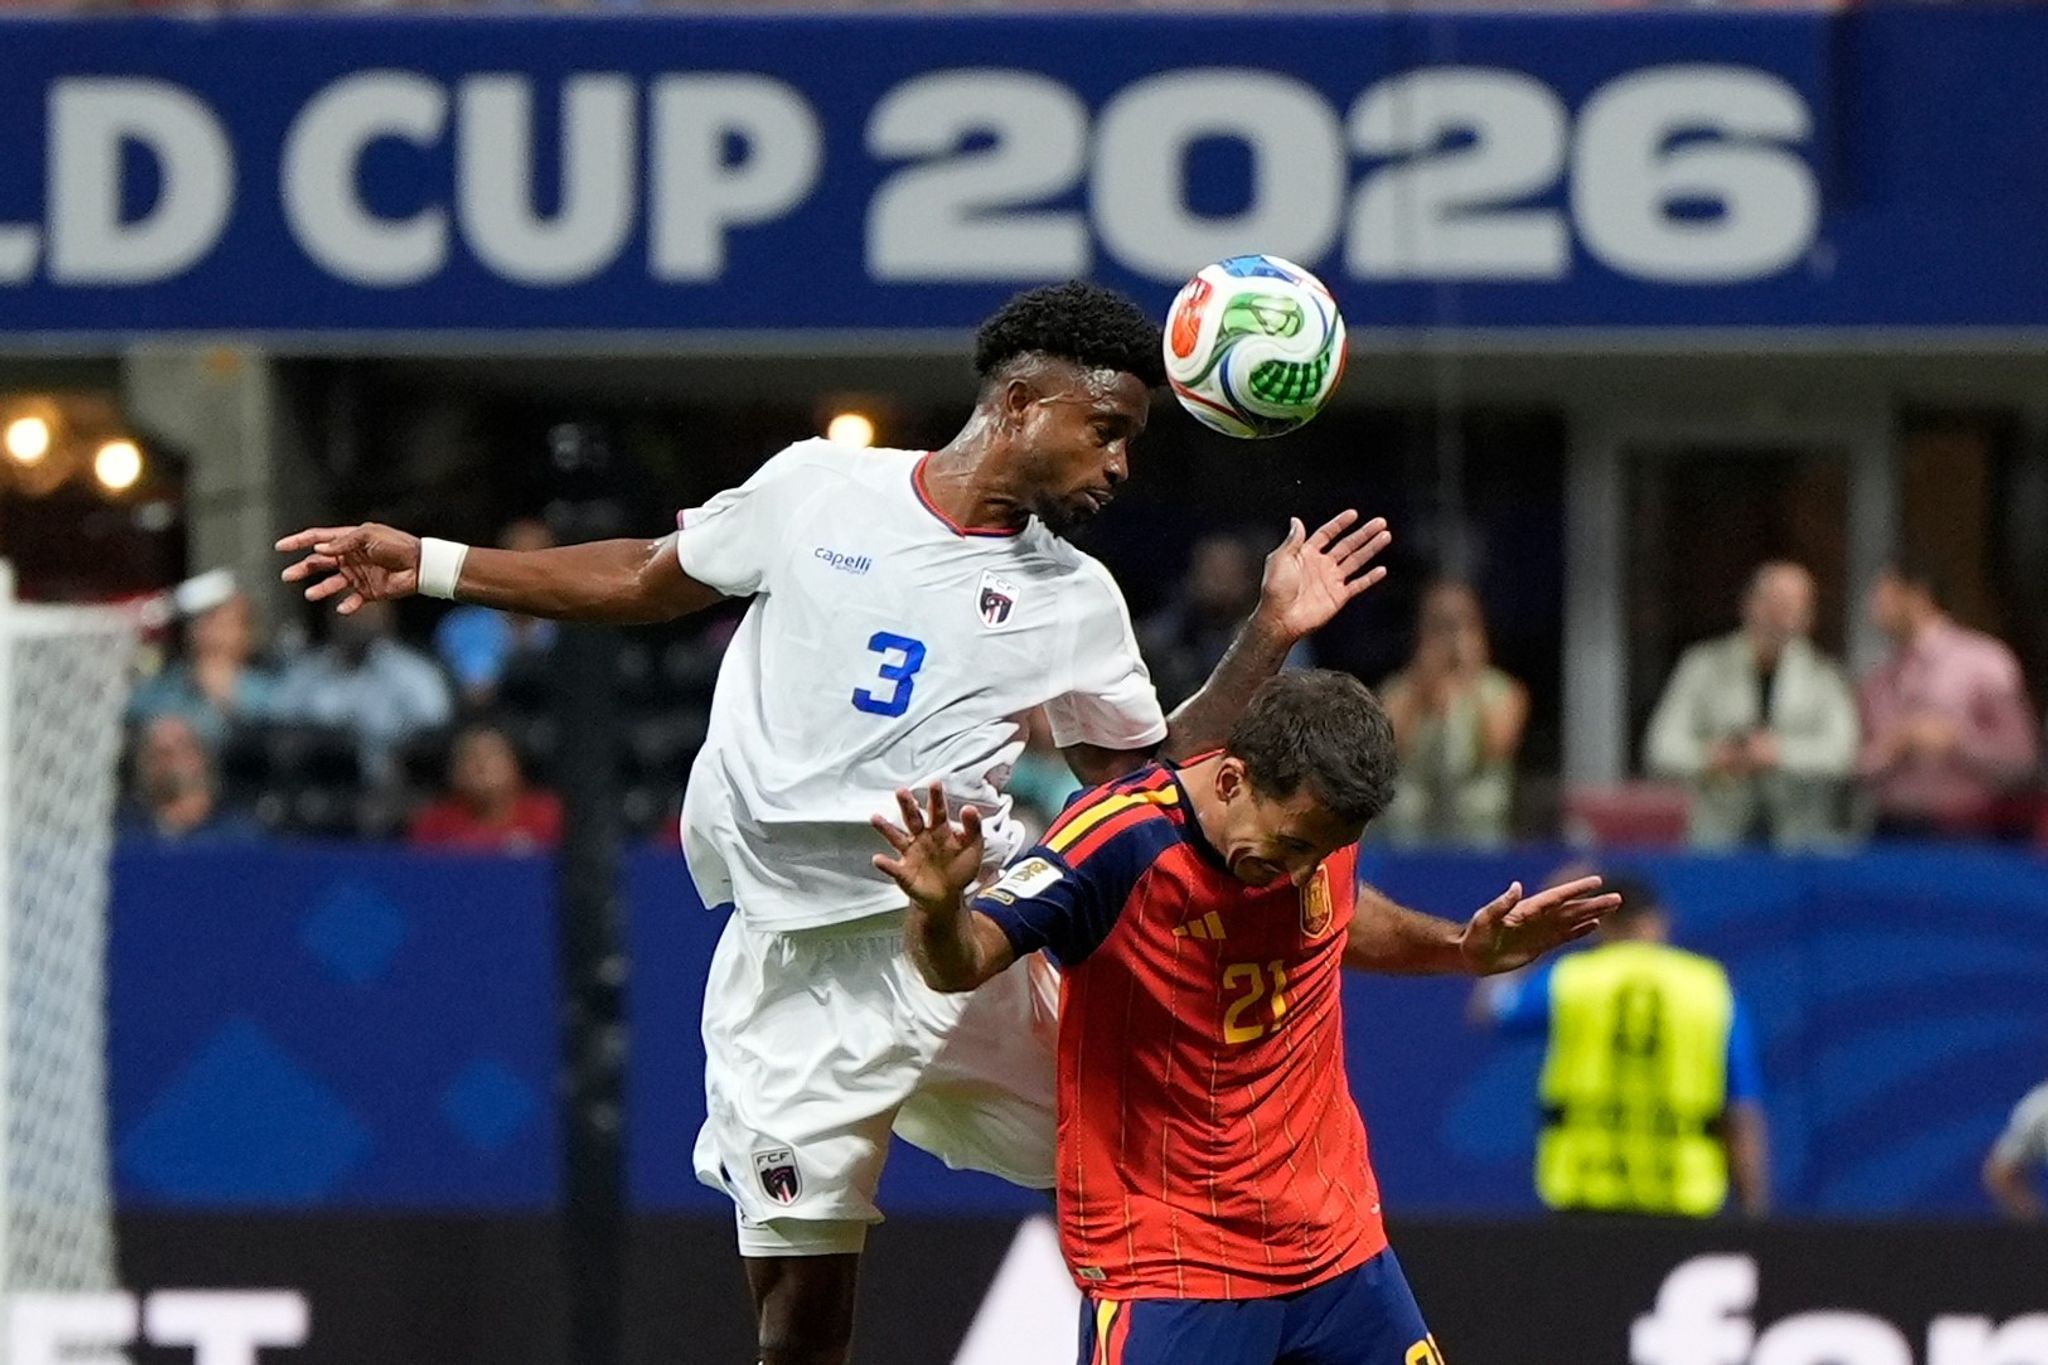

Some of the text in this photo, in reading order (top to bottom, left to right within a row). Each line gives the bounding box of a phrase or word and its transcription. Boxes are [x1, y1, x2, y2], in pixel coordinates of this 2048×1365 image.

[0, 64, 1821, 287] D CUP 2026
[814, 547, 872, 572] capelli
[852, 631, 926, 718] 3
[1223, 959, 1287, 1044] 21
[756, 1151, 790, 1167] FCF
